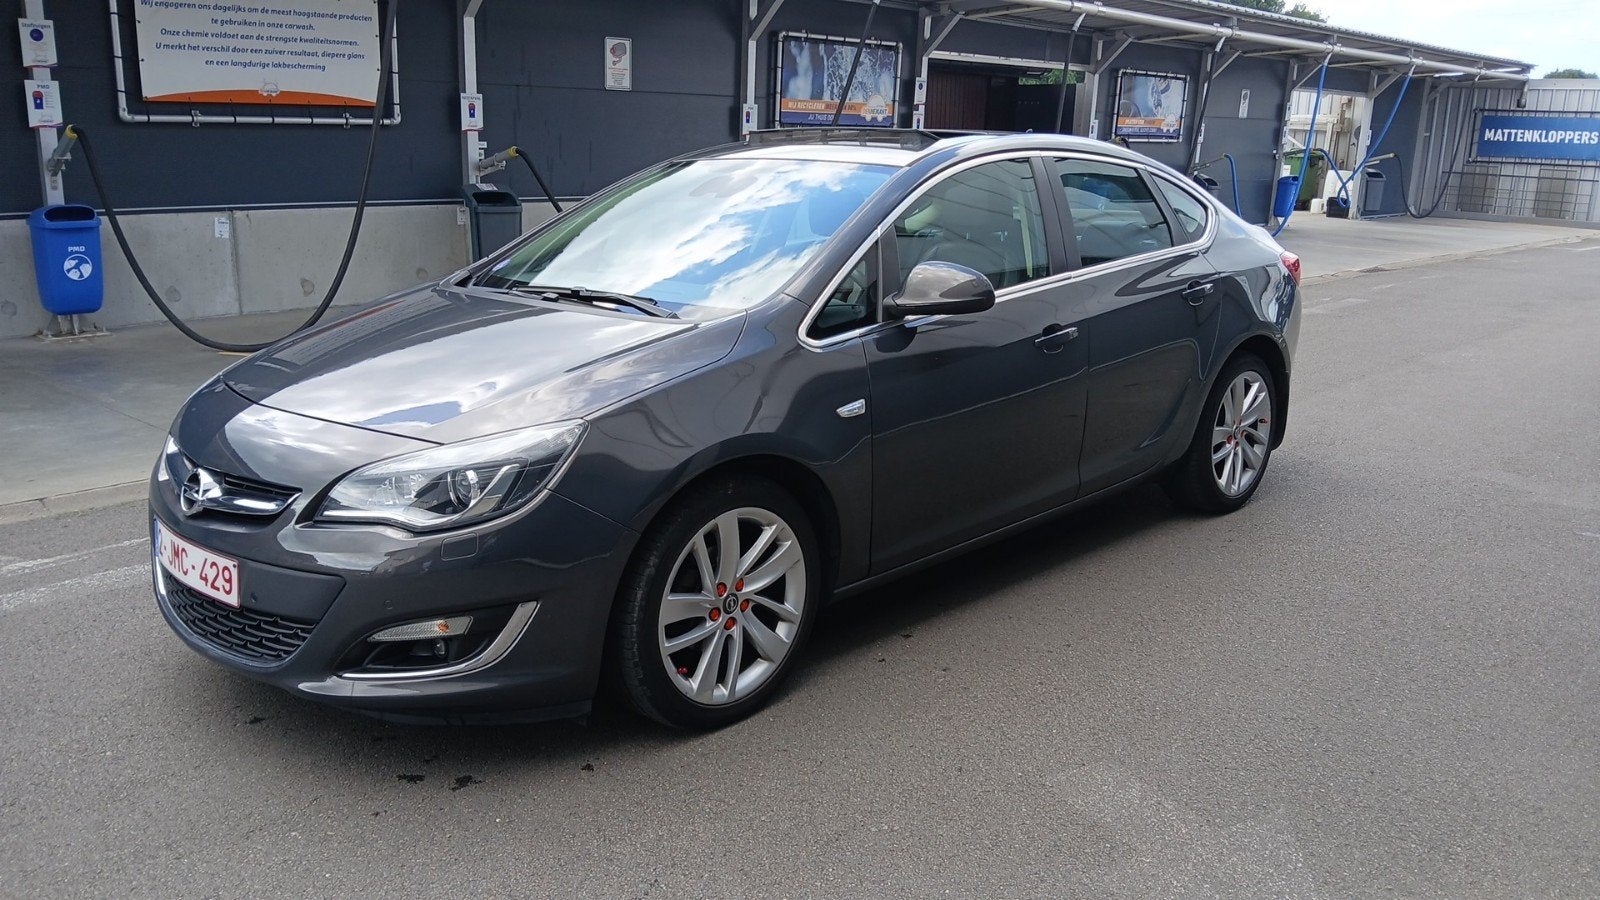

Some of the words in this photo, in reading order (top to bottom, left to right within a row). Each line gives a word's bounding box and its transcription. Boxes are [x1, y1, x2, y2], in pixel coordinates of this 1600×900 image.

[155, 1, 197, 10] engageren
[212, 4, 246, 13] dagelijks
[260, 6, 269, 14] de
[270, 8, 292, 16] meest
[293, 8, 338, 19] hoogstaande
[338, 13, 372, 22] producten
[220, 18, 257, 27] gebruiken
[285, 23, 316, 31] carwash.
[160, 28, 180, 36] Onze
[181, 29, 209, 38] chemie
[210, 31, 239, 39] voldoet
[255, 33, 265, 41] de
[265, 35, 297, 43] strengste
[299, 37, 359, 46] kwaliteitsnormen.
[163, 42, 186, 50] merkt
[187, 43, 200, 51] het
[201, 44, 230, 53] verschil
[231, 45, 249, 53] door
[264, 47, 286, 55] zuiver
[287, 49, 320, 58] resultaat,
[321, 50, 346, 59] diepere
[347, 52, 365, 60] glans
[230, 60, 271, 69] langdurige
[271, 61, 326, 71] lakbescherming
[1484, 128, 1599, 145] MATTENKLOPPERS
